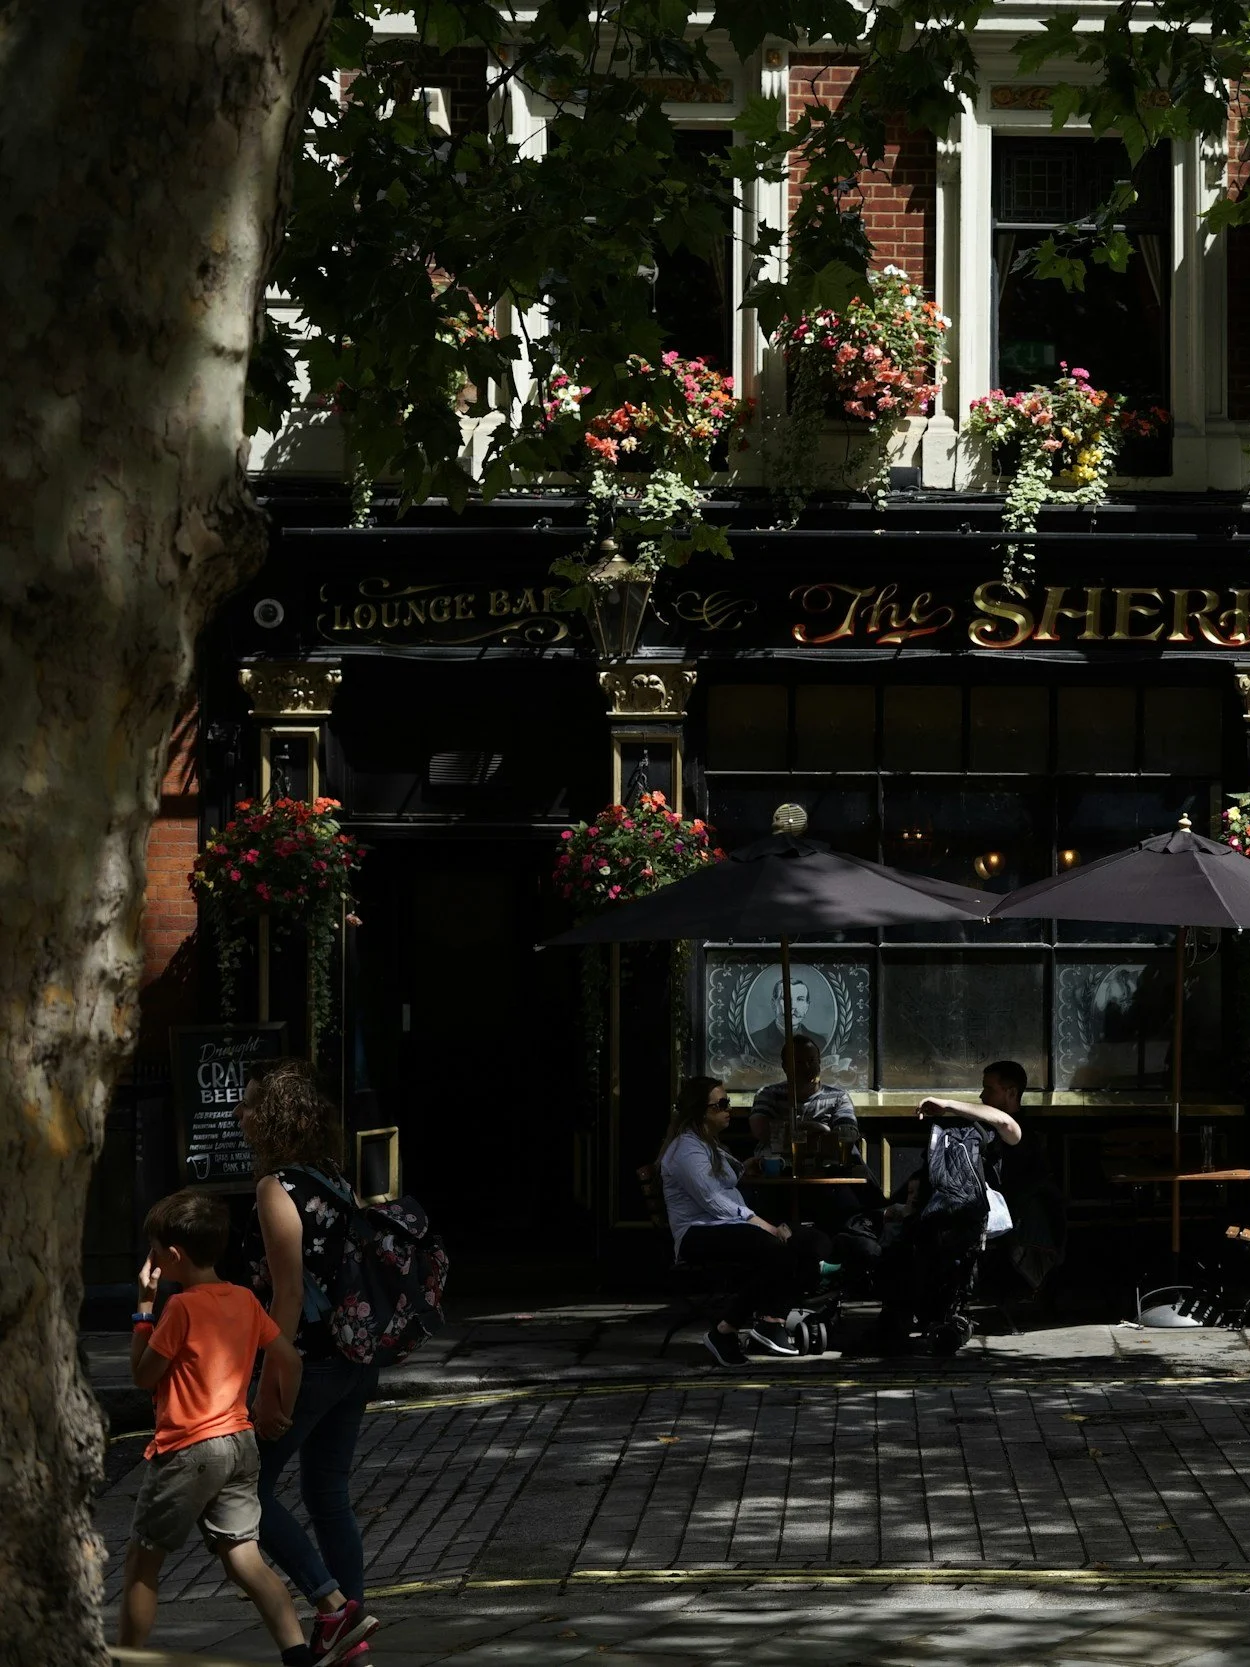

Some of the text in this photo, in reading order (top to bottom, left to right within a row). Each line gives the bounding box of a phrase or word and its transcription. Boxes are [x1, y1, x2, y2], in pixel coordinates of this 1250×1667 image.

[332, 591, 476, 631] LOUNGE
[789, 581, 956, 647] The
[197, 1062, 250, 1089] CRAF
